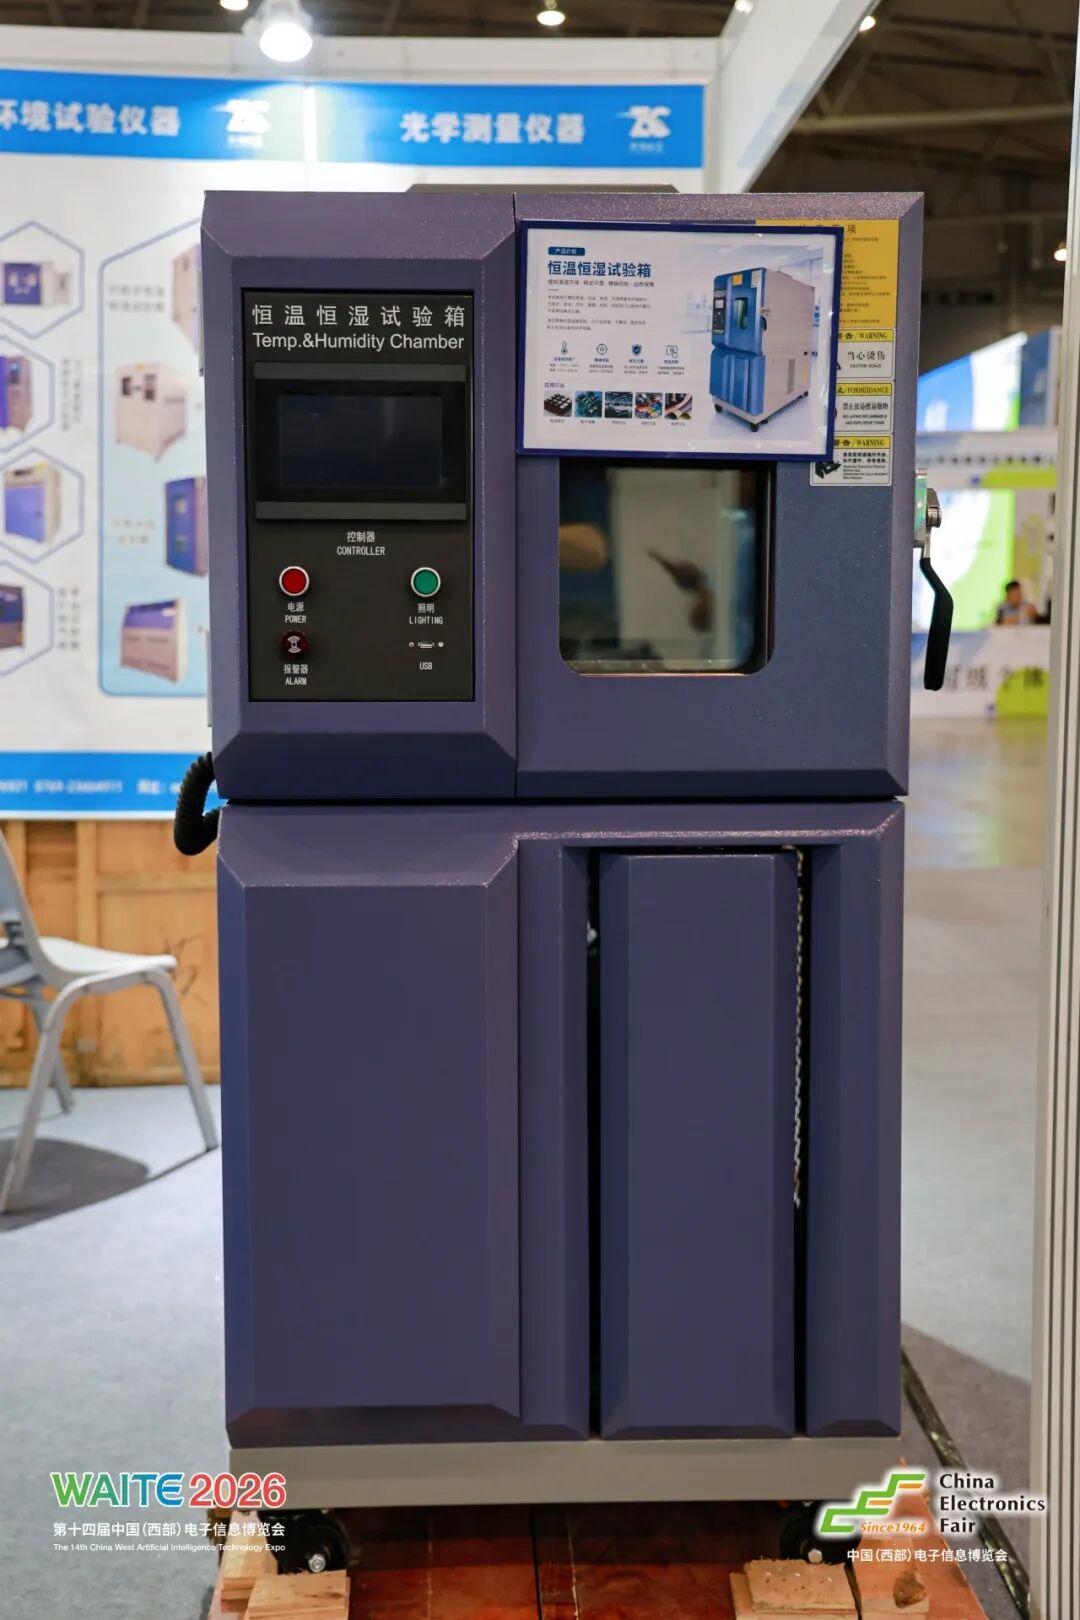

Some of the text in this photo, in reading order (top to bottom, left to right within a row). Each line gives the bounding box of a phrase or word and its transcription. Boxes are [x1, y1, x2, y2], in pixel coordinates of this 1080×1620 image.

[399, 111, 585, 144] 光学测量仪器
[547, 260, 652, 278] 恒温恒湿试验箱
[252, 304, 465, 328] 恒温恒湿试验箱
[252, 332, 465, 352] Temp.&Humidity Chamber
[347, 531, 375, 543] 控制器
[336, 546, 386, 556] CONTROLLER
[287, 601, 304, 612] 电源
[418, 603, 435, 613] 照明
[284, 614, 307, 623] POWER
[409, 616, 444, 625] LIGHTING
[283, 663, 308, 674] 报警器
[419, 661, 433, 670] USB
[285, 677, 307, 685] ALARM
